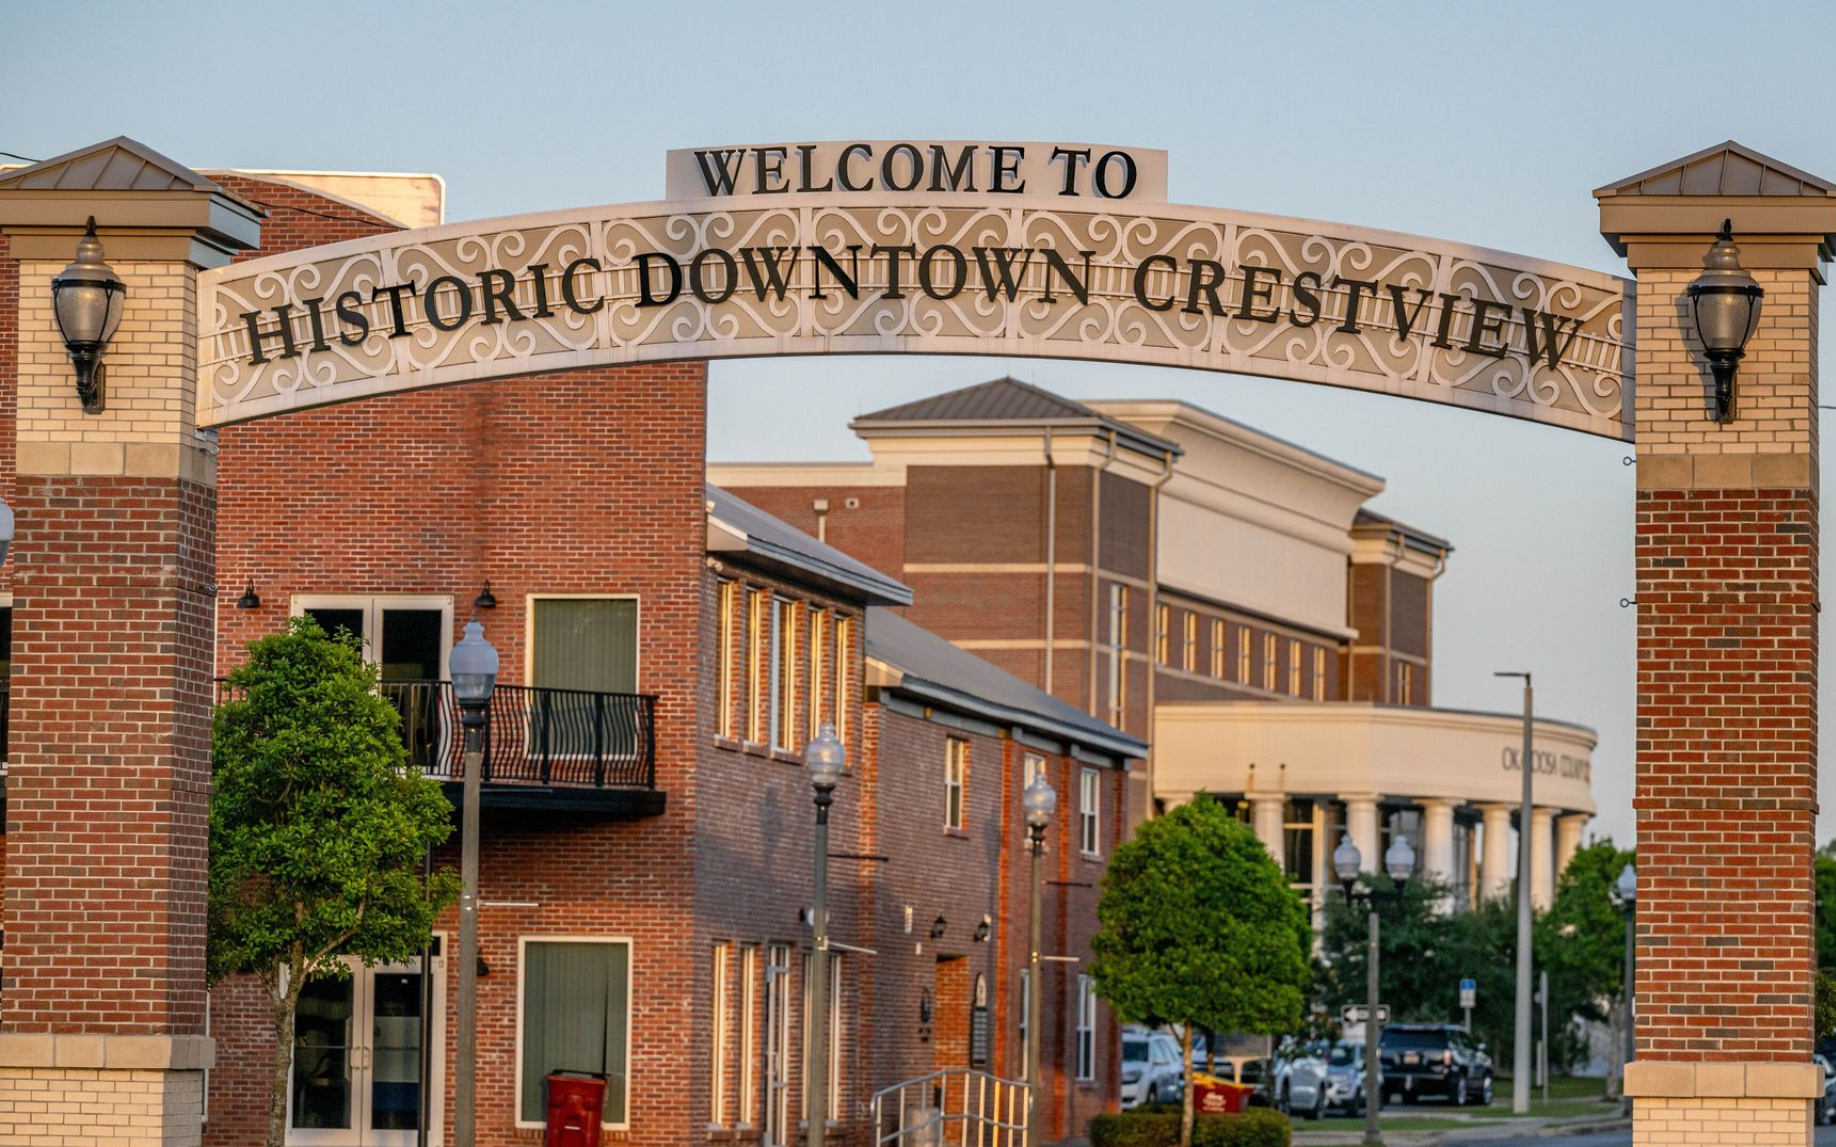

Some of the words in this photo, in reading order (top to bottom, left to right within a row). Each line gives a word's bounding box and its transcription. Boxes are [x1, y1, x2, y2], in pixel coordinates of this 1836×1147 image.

[694, 143, 1026, 197] WELCOME
[1051, 146, 1137, 199] TO
[240, 258, 605, 366] HISTORIC
[632, 243, 1096, 308] DOWNTOWN
[1133, 254, 1585, 371] CRESTVIEW
